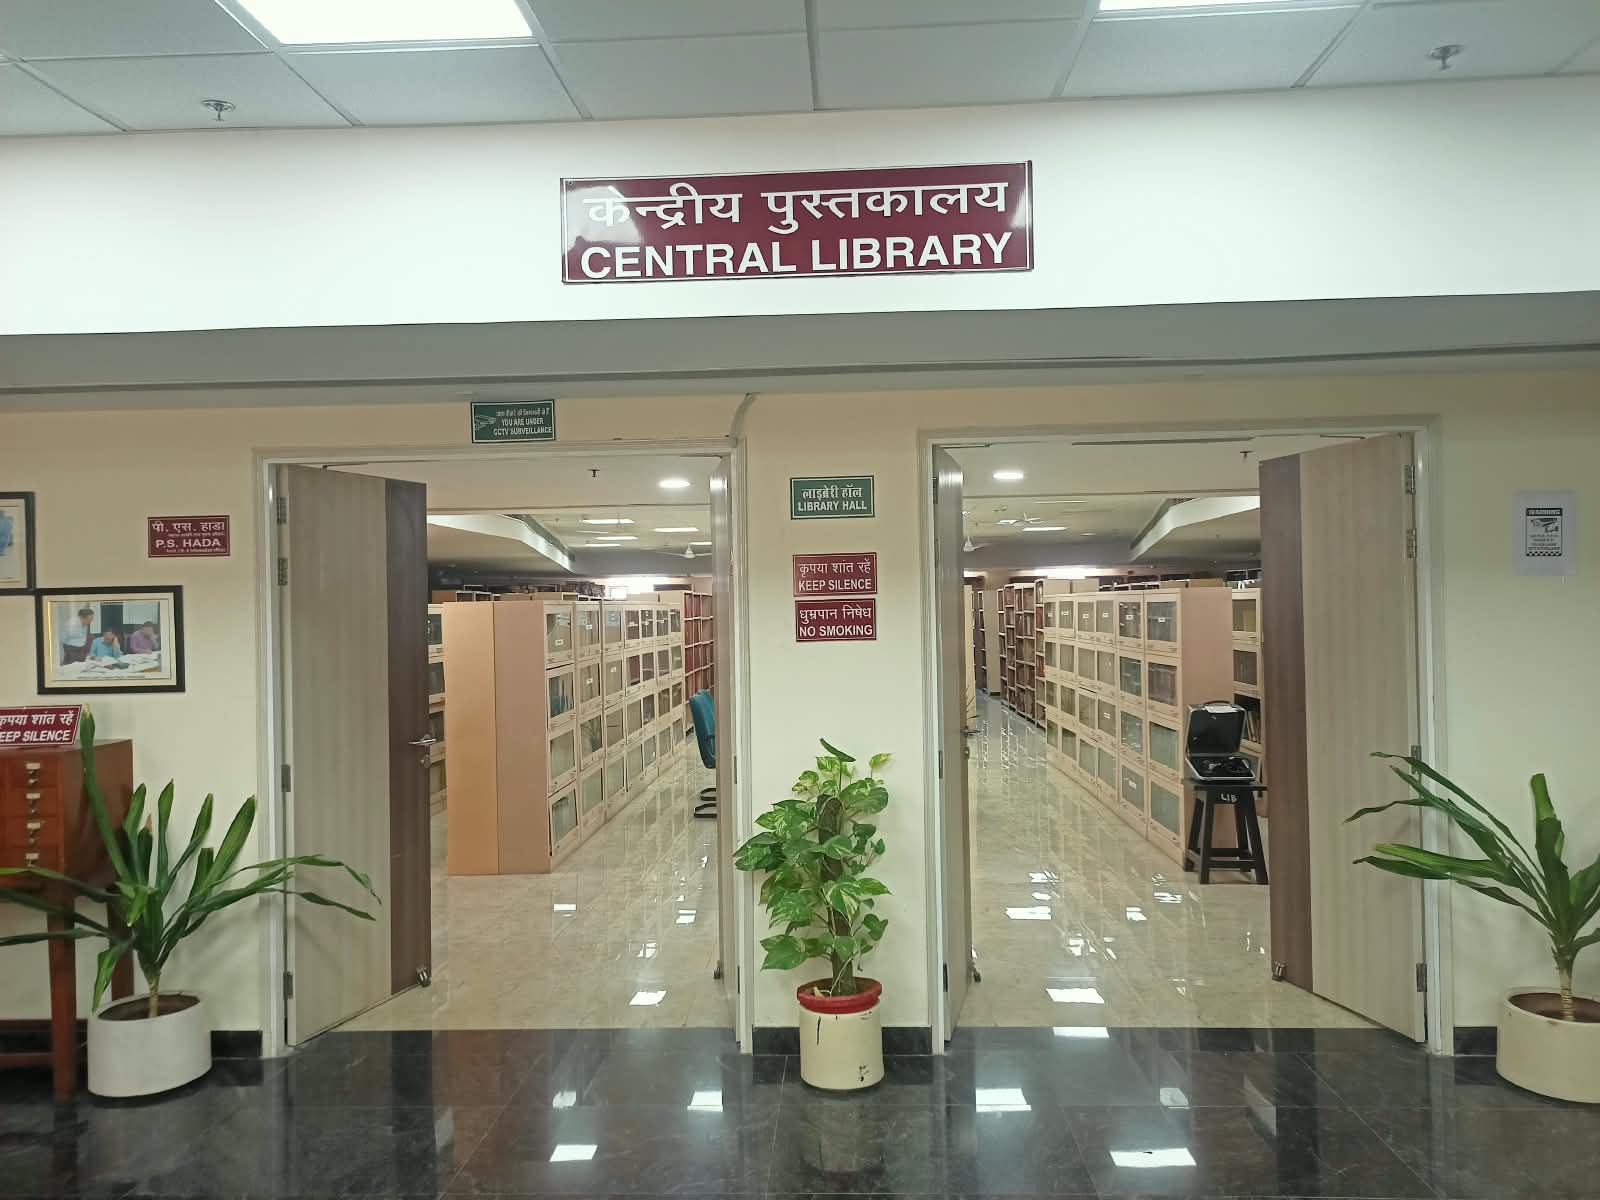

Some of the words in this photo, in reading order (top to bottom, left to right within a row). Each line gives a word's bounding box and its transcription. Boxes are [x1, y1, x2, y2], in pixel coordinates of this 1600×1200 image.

[583, 182, 743, 230] केन्द्रीय
[760, 182, 1008, 235] पुस्तकालय
[580, 241, 797, 279] CENTRAL
[811, 232, 1012, 272] LIBRARY
[502, 418, 513, 426] YOU
[514, 418, 524, 426] ARE
[494, 428, 508, 436] CCTV
[510, 427, 552, 435] SURVEILLANCE
[798, 501, 839, 512] LIBRARY
[842, 500, 867, 511] HALL
[155, 539, 179, 549] P.S.
[182, 538, 221, 548] HADA
[798, 563, 828, 578] कृपया
[831, 559, 854, 574] शांत
[856, 557, 871, 574] रहें
[799, 580, 826, 592] KEEP
[828, 578, 872, 591] SILENCE
[841, 603, 872, 620] निषेध
[799, 626, 816, 637] NO
[819, 624, 873, 637] SMOKING
[31, 710, 56, 725] शांत
[59, 709, 75, 726] रहें
[0, 731, 21, 743] EEP
[22, 729, 71, 742] SILENCE
